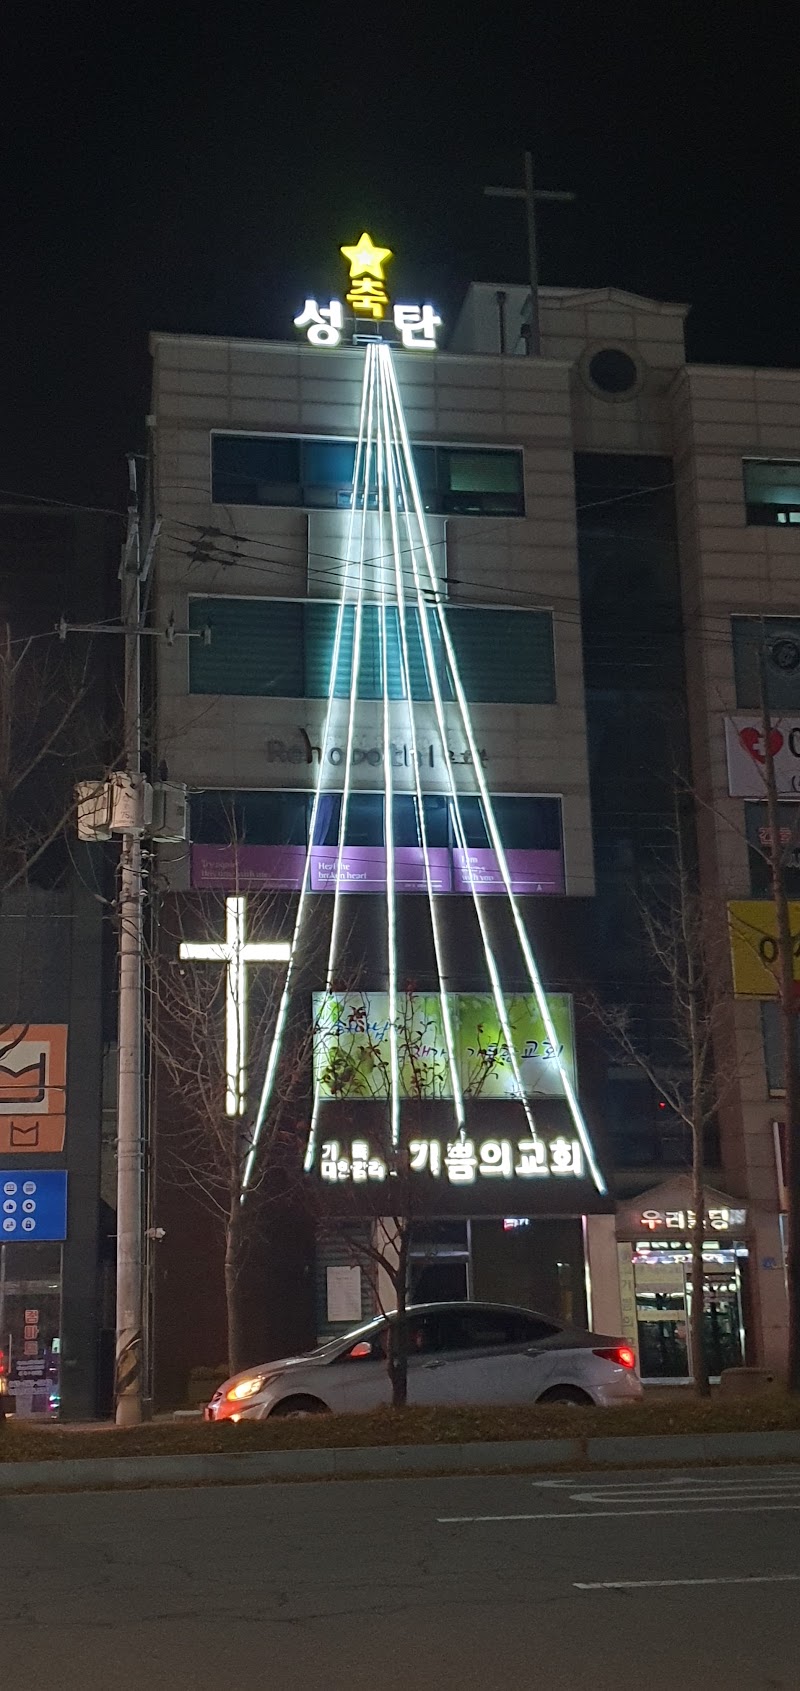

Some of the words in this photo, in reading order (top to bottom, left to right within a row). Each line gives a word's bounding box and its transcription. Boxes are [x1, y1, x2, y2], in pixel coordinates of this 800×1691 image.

[346, 277, 389, 319] 축
[338, 862, 350, 870] he
[521, 1040, 564, 1060] 교회
[409, 1141, 583, 1184] 기쁨의교회
